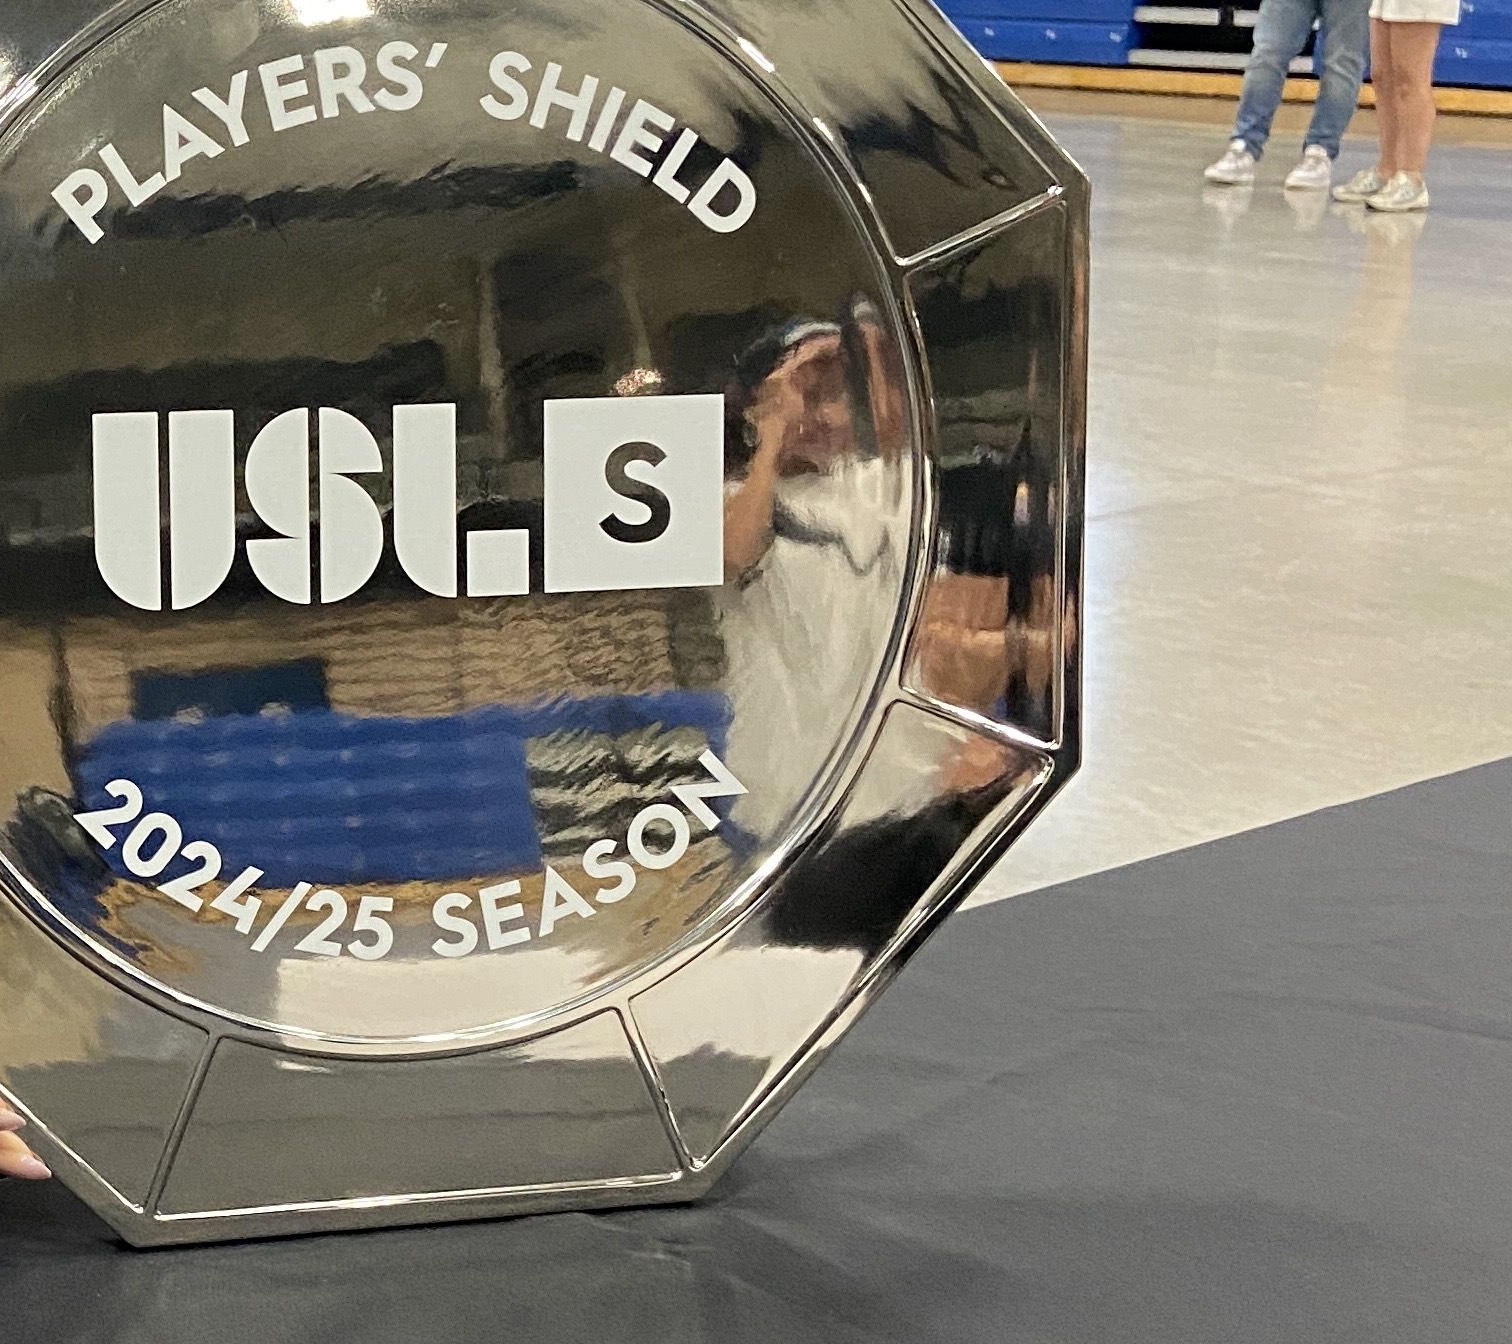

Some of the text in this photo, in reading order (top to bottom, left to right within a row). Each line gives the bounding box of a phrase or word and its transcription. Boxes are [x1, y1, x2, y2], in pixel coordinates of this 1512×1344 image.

[51, 41, 757, 244] PLAYERS' SHIELD
[92, 401, 670, 612] USL S
[74, 749, 750, 959] 2024/25 SEASON
